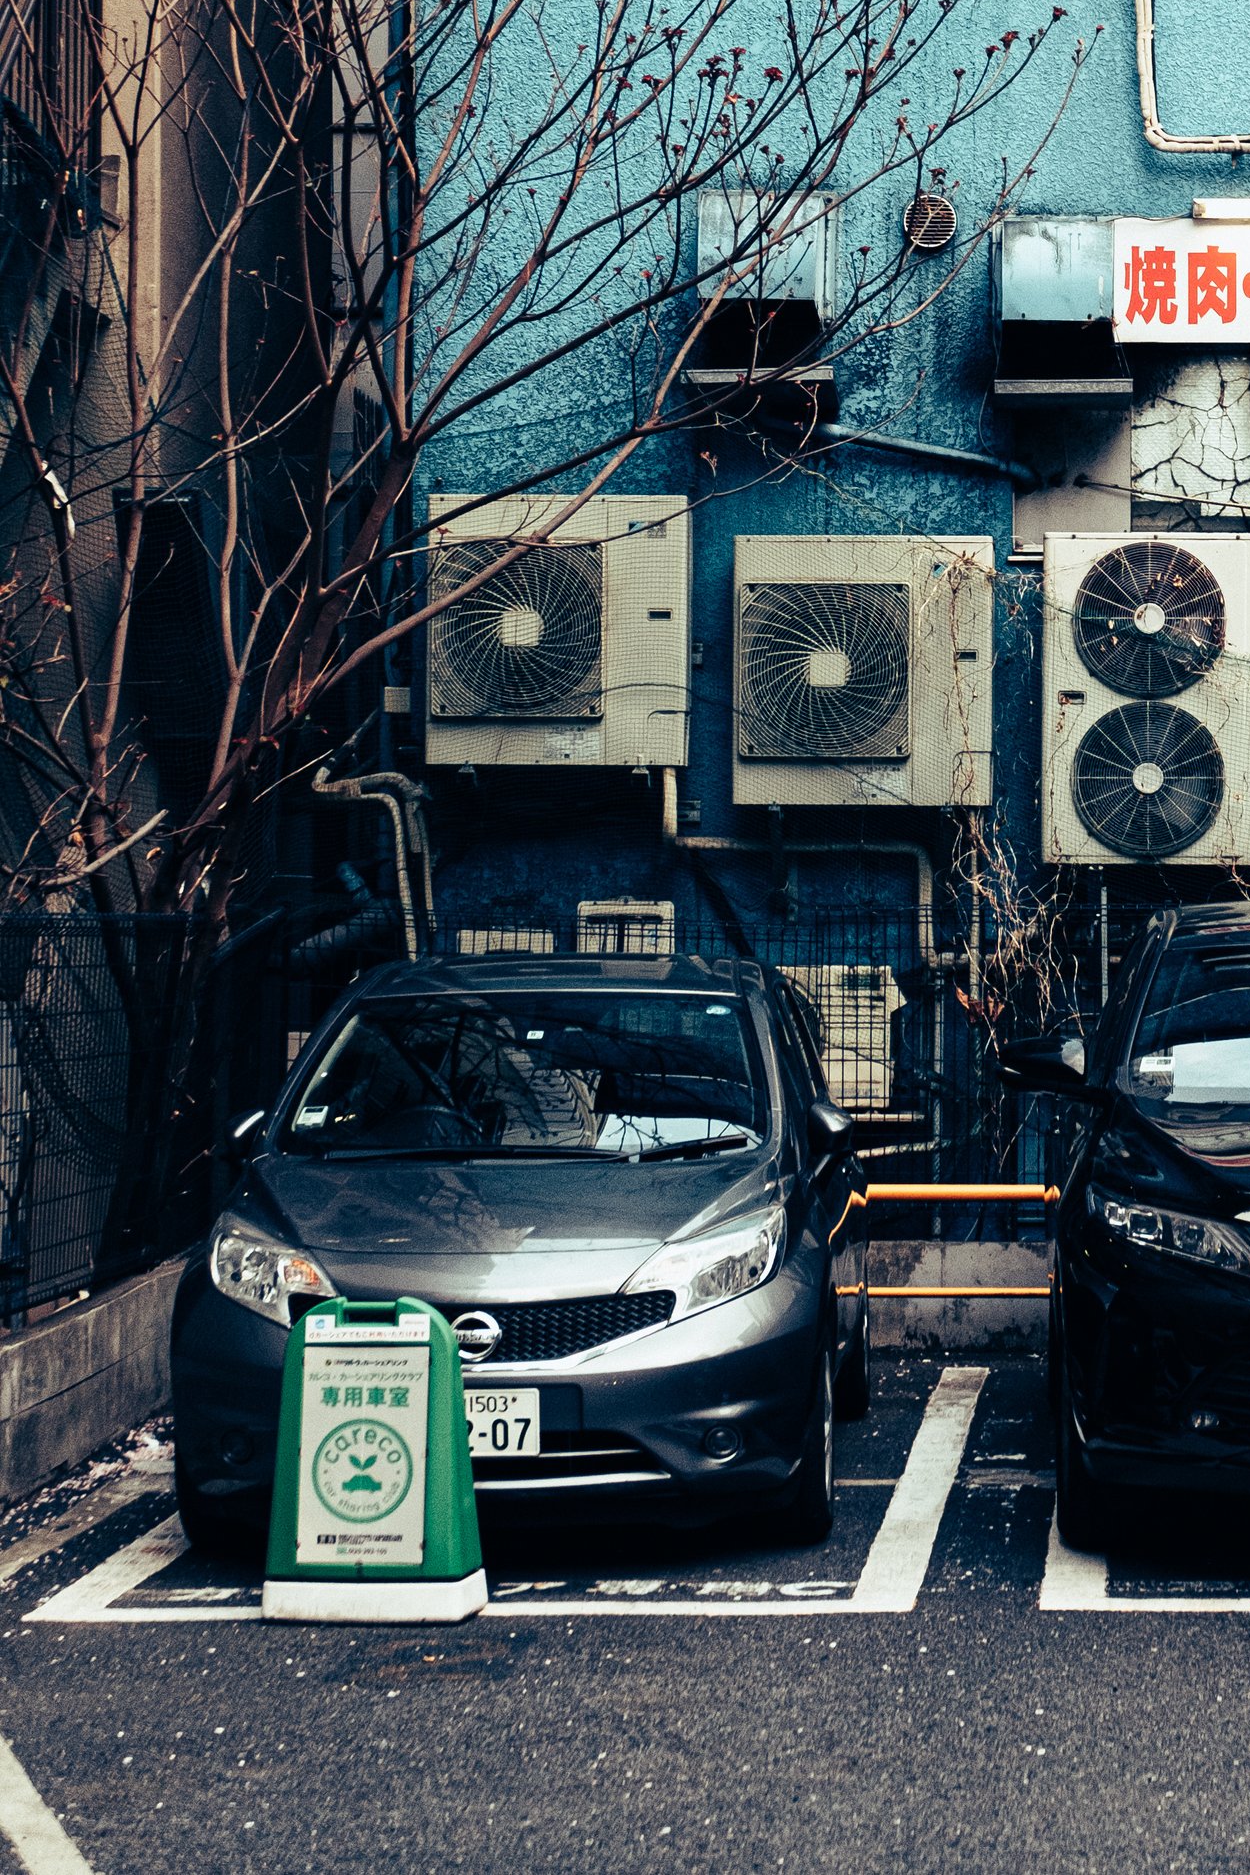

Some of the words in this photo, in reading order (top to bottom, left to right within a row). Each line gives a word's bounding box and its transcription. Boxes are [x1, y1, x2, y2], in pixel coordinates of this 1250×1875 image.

[319, 1384, 412, 1408] 専用車室
[324, 1426, 403, 1465] careco
